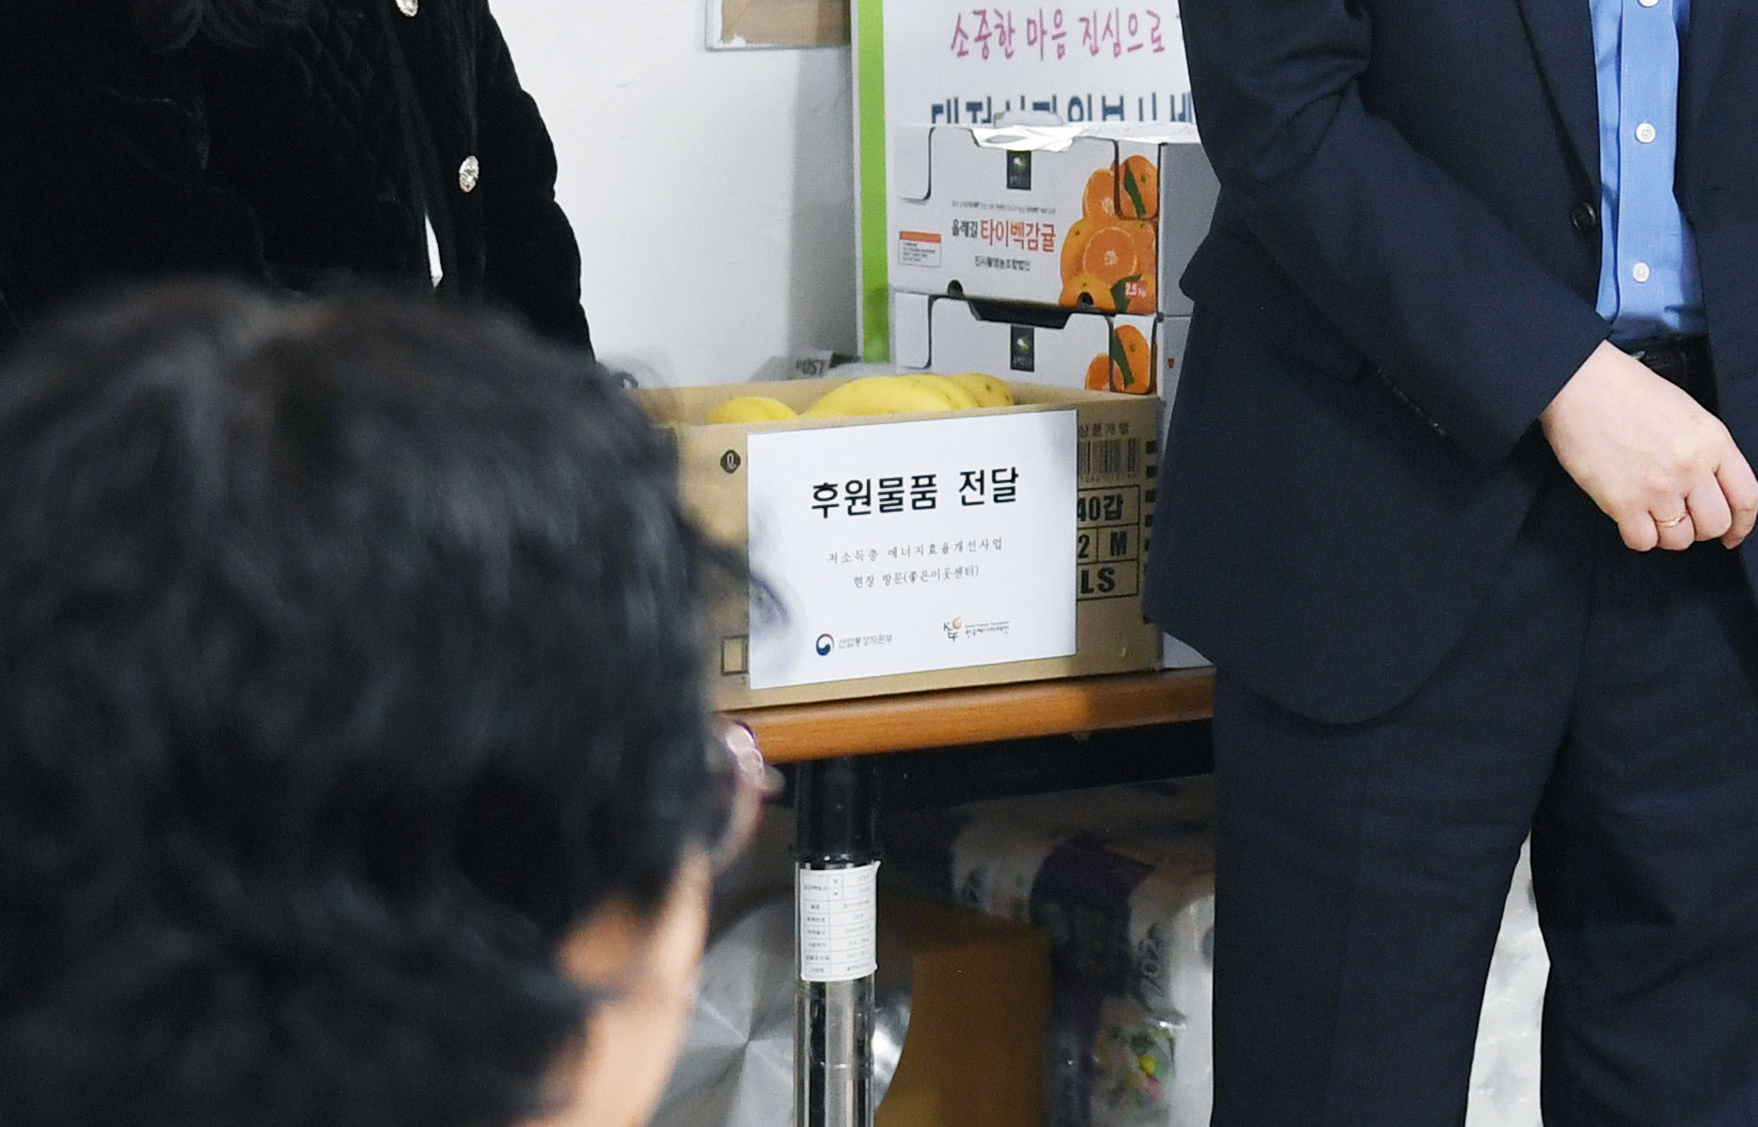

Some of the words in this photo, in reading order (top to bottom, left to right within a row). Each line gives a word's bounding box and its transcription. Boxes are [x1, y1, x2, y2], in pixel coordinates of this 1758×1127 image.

[950, 7, 1015, 60] 소중한
[1026, 7, 1067, 61] 마음
[1079, 7, 1165, 59] 진심으로
[810, 472, 939, 519] 후원물품
[957, 466, 1019, 507] 전달
[828, 547, 879, 564] 저소득층
[888, 536, 1003, 559] 에너지효율개선사업
[1110, 530, 1128, 557] M
[853, 574, 875, 589] 현장
